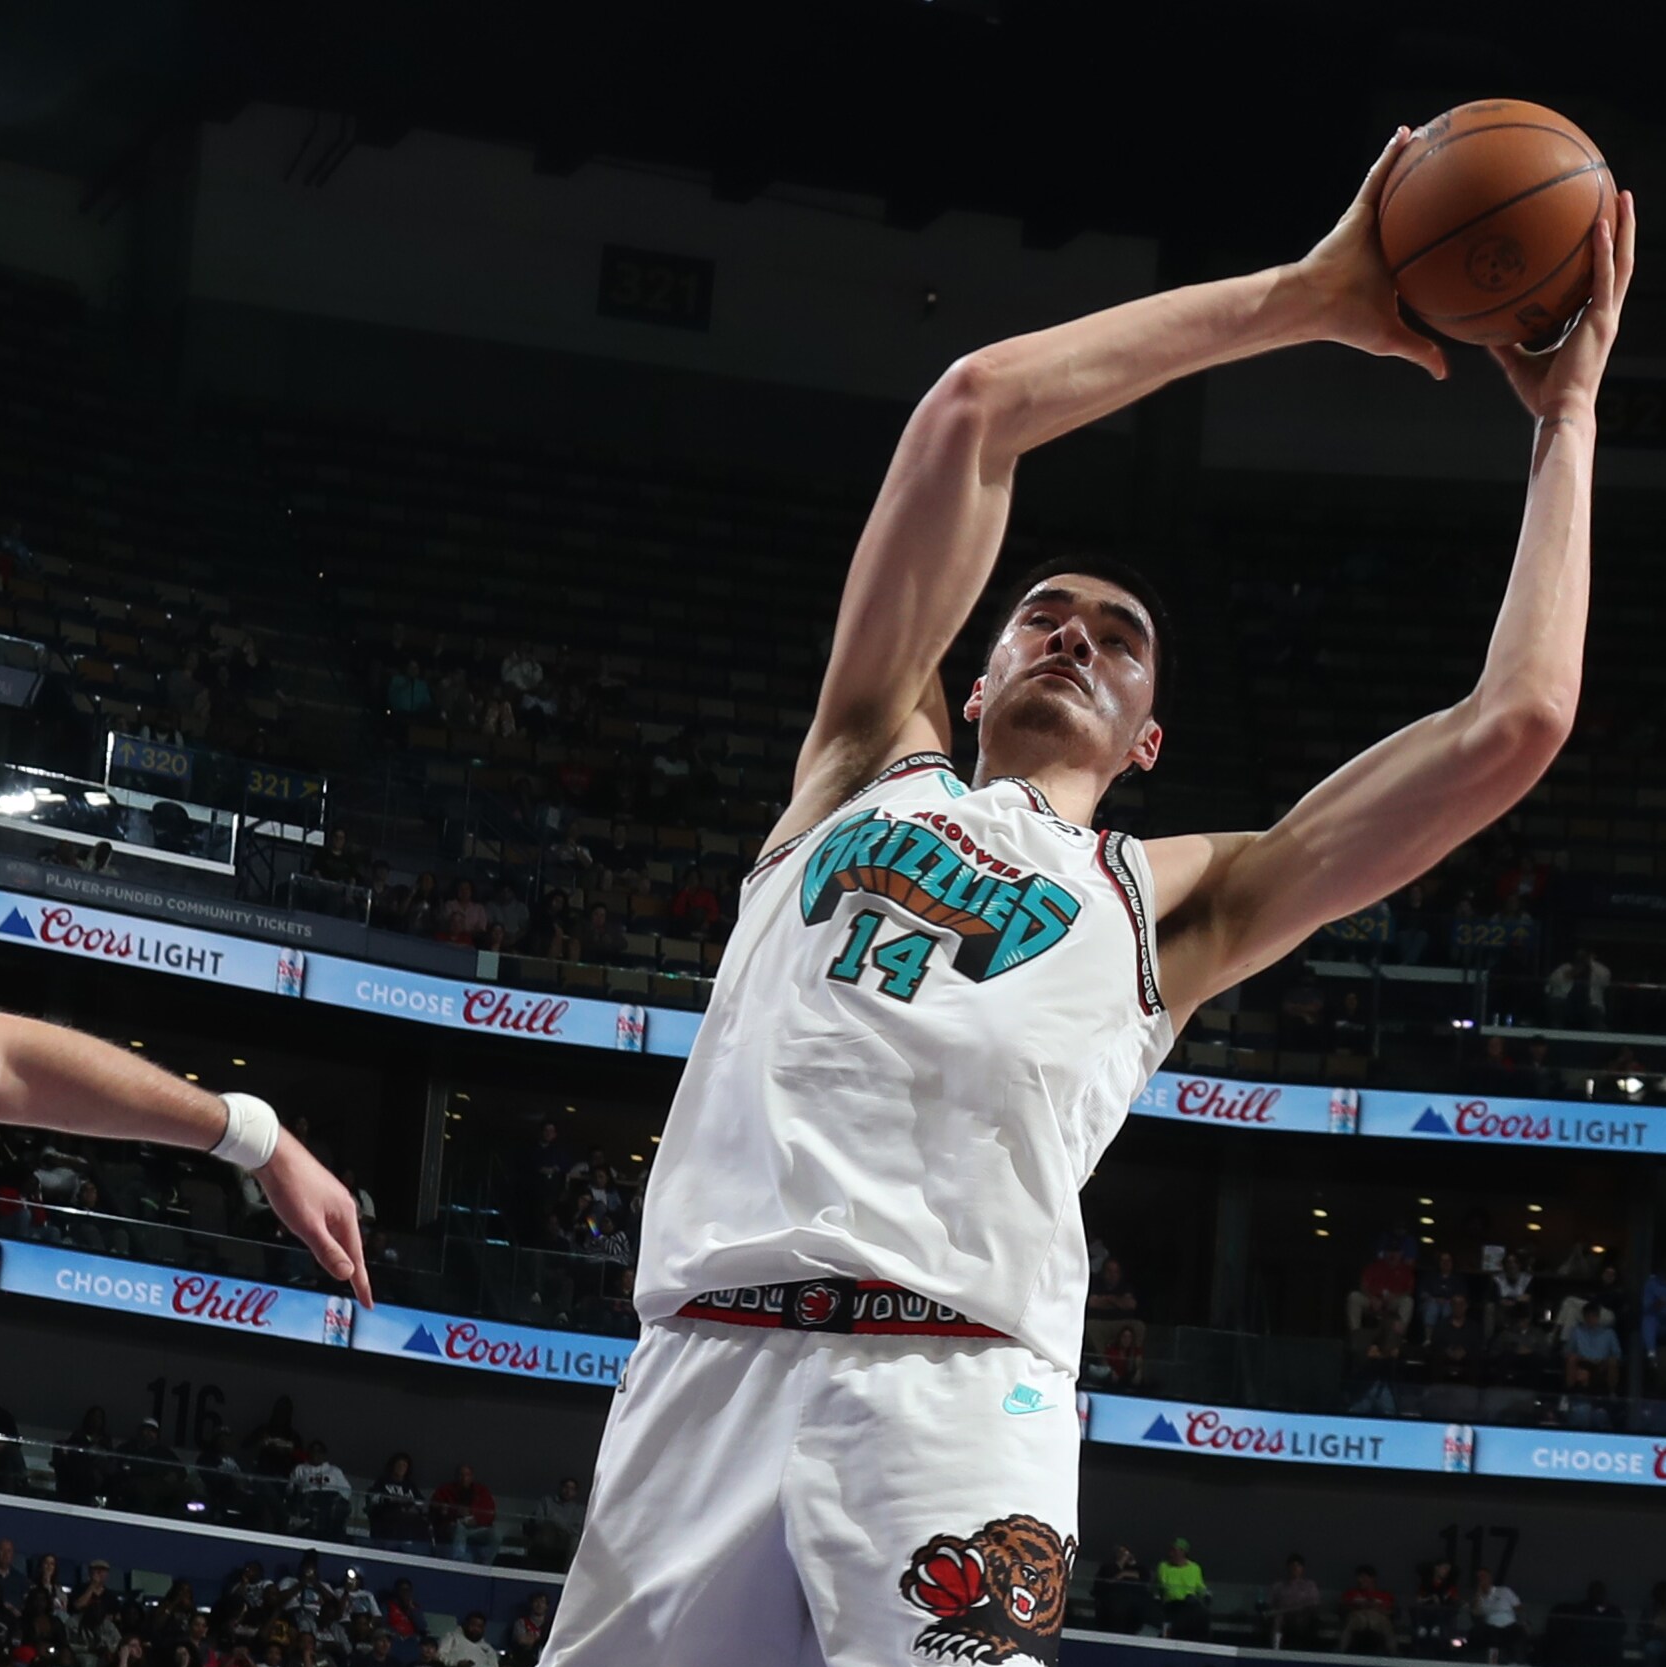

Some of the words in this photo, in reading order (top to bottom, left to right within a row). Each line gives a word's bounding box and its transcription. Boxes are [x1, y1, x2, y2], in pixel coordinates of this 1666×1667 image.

[140, 748, 188, 777] 320
[247, 770, 290, 798] 321
[44, 873, 164, 909] PLAYER-FUNDED
[166, 897, 252, 926] COMMUNITY
[254, 914, 313, 938] TICKETS
[800, 807, 1082, 984] GRIZZLIES
[40, 906, 132, 958] Coors
[137, 937, 225, 977] LIGHT
[825, 908, 940, 1004] 14
[355, 980, 455, 1018] CHOOSE
[462, 989, 570, 1036] Chill
[1176, 1079, 1283, 1124] Chill
[1454, 1100, 1554, 1143] Coors
[1556, 1119, 1650, 1147] LIGHT
[55, 1268, 164, 1307] CHOOSE
[172, 1275, 279, 1328] Chill
[445, 1321, 542, 1371] Coors
[544, 1348, 626, 1382] LIGH
[147, 1376, 226, 1450] 116
[1185, 1408, 1286, 1456] Coors
[1290, 1431, 1386, 1463] LIGHT
[1532, 1446, 1644, 1476] CHOOSE
[1439, 1523, 1520, 1588] 117
